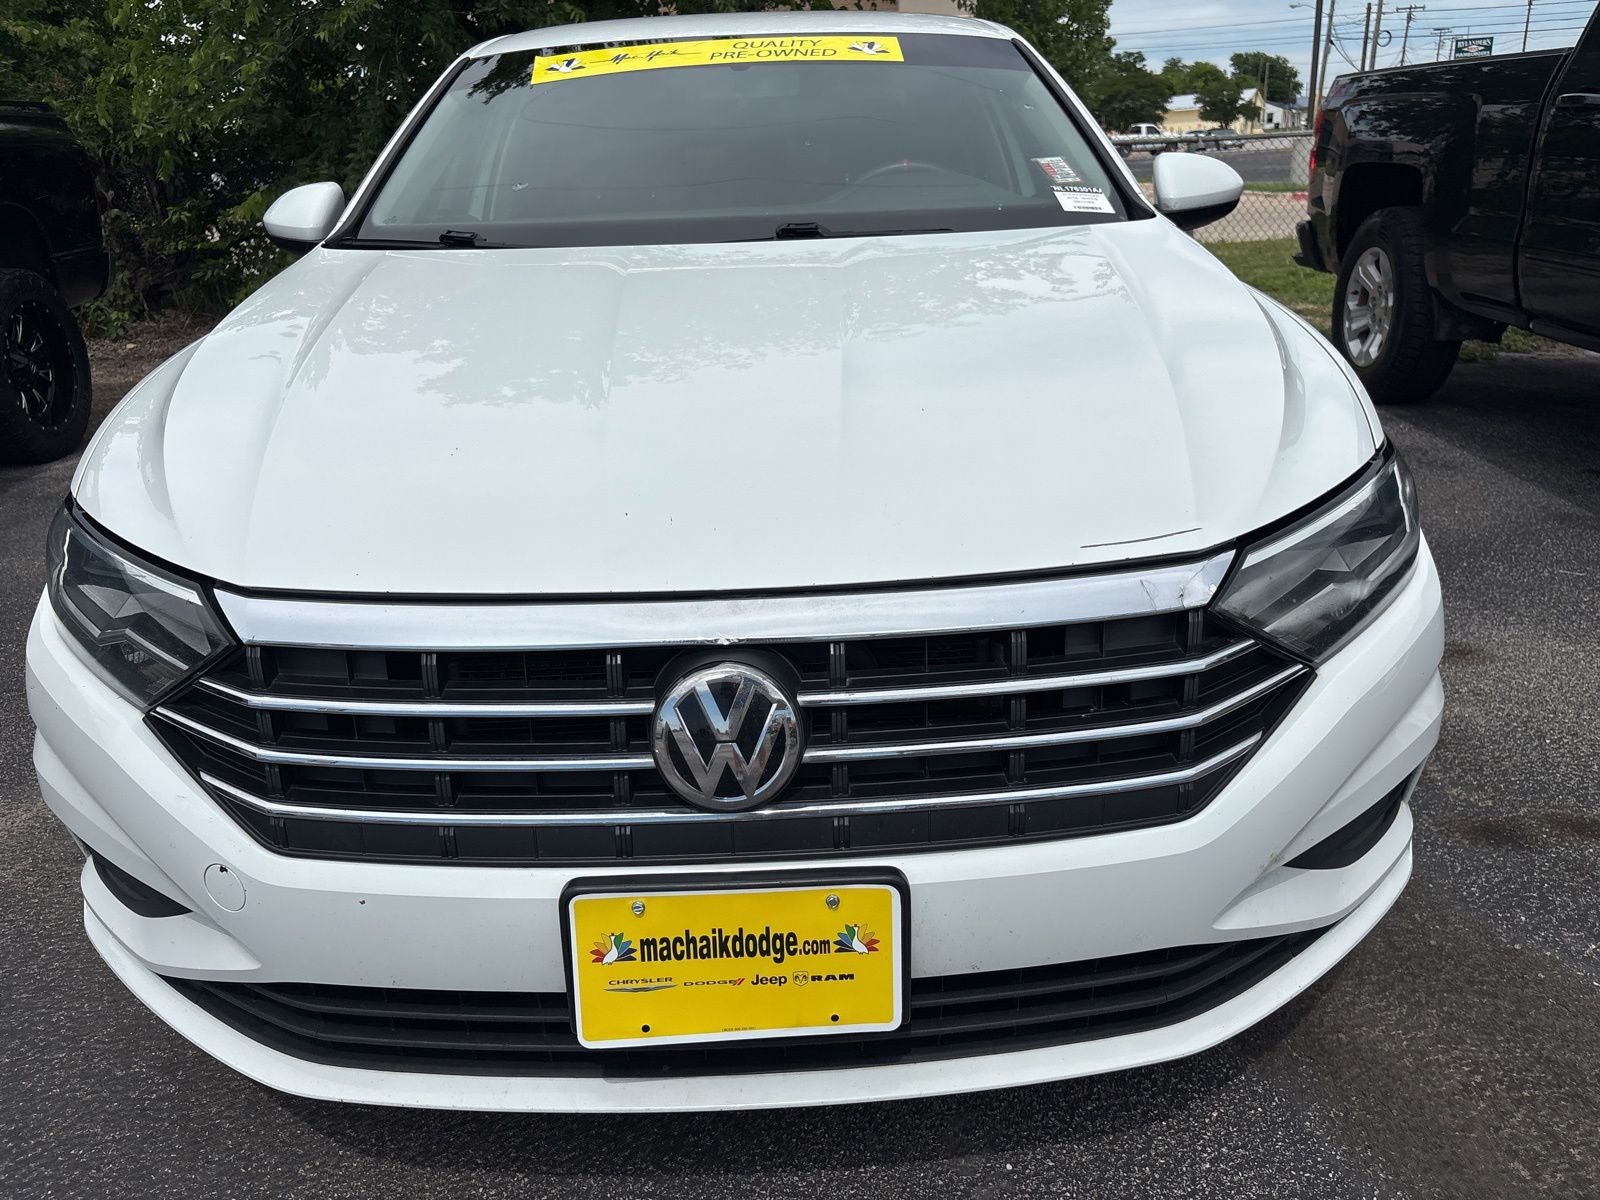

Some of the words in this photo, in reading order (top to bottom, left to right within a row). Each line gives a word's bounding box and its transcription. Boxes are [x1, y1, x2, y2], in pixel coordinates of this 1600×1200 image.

[732, 39, 823, 50] QUALITY
[709, 48, 838, 61] PRE-OWNED
[639, 926, 831, 964] machaikdodge.com
[608, 977, 673, 986] CHRYSLER
[683, 979, 737, 987] DODGE
[751, 974, 788, 987] Jeep
[810, 973, 855, 982] RAM
